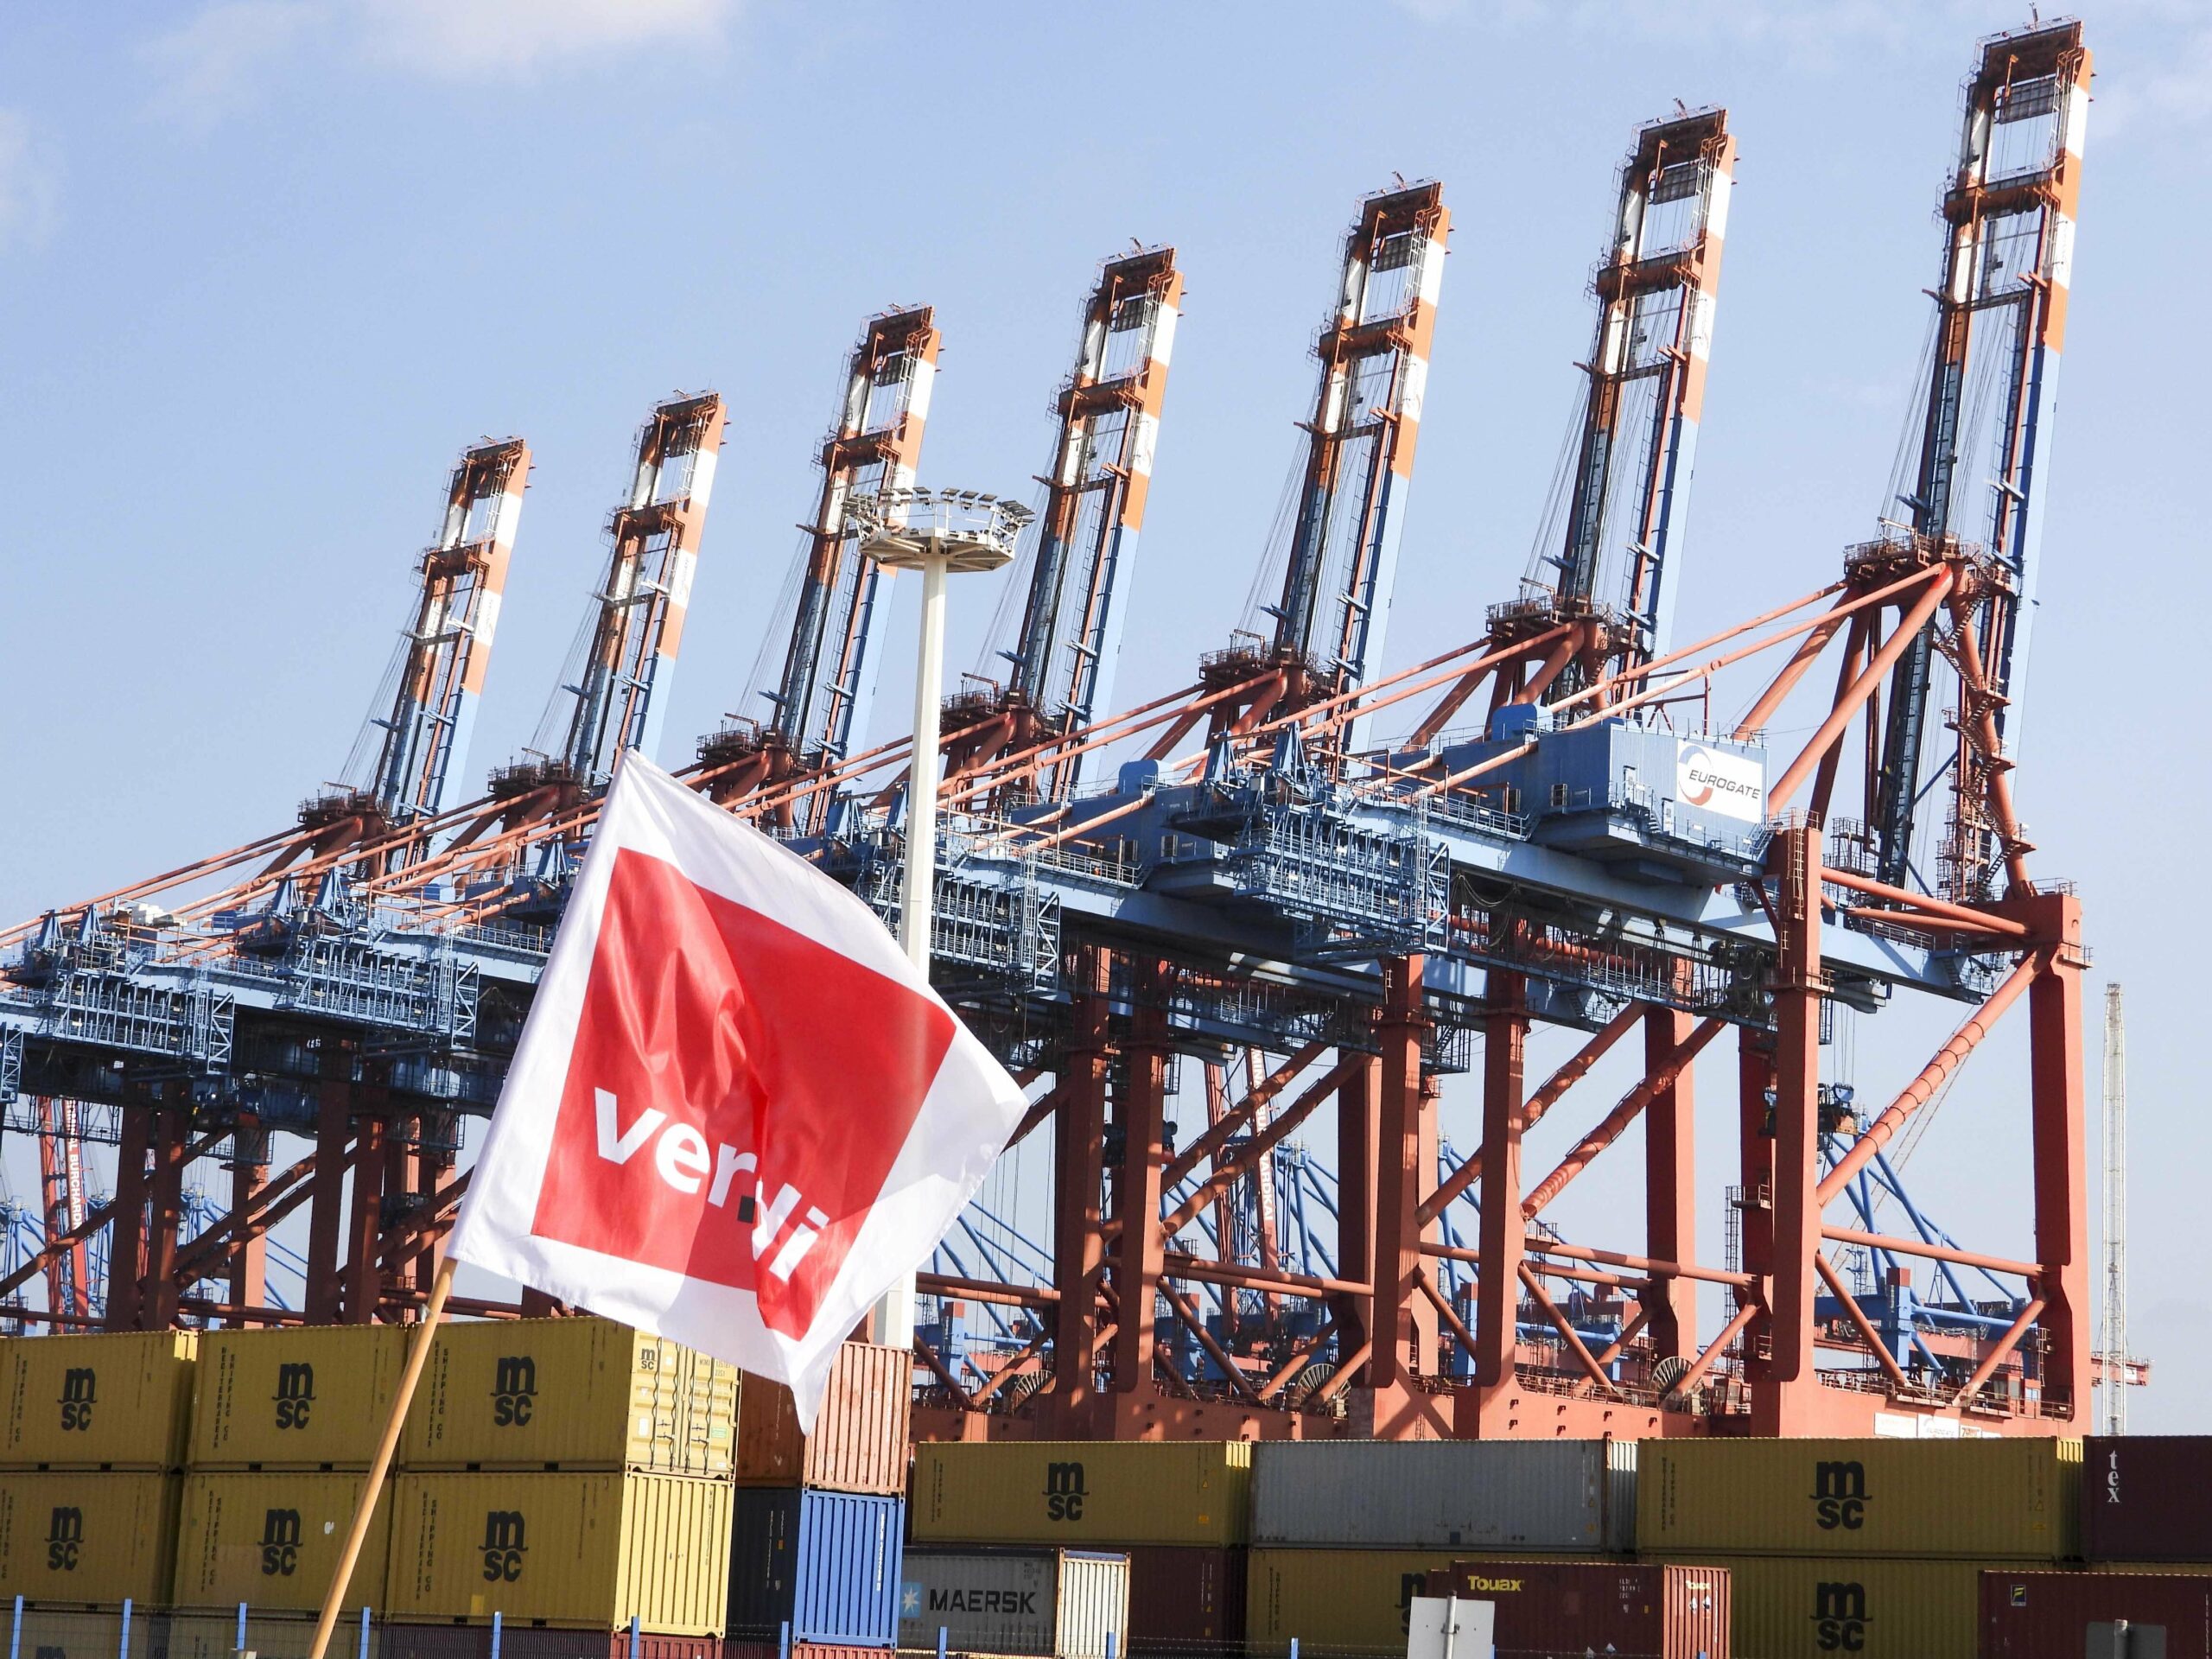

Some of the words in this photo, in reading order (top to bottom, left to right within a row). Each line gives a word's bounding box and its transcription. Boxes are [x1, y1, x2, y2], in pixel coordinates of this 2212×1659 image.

[1688, 769, 1761, 799] EUROGATE
[641, 1348, 656, 1361] m
[60, 1368, 97, 1403] m
[272, 1363, 315, 1399] m
[491, 1356, 537, 1396] m
[436, 1423, 442, 1440] CO
[1043, 1462, 1090, 1496] m
[1811, 1461, 1872, 1500] m
[2107, 1450, 2120, 1503] tex
[46, 1506, 84, 1542] m
[258, 1509, 302, 1546] m
[480, 1510, 527, 1551] m
[424, 1575, 431, 1592] CO
[929, 1589, 1036, 1614] MAERSK
[1811, 1582, 1872, 1622] m
